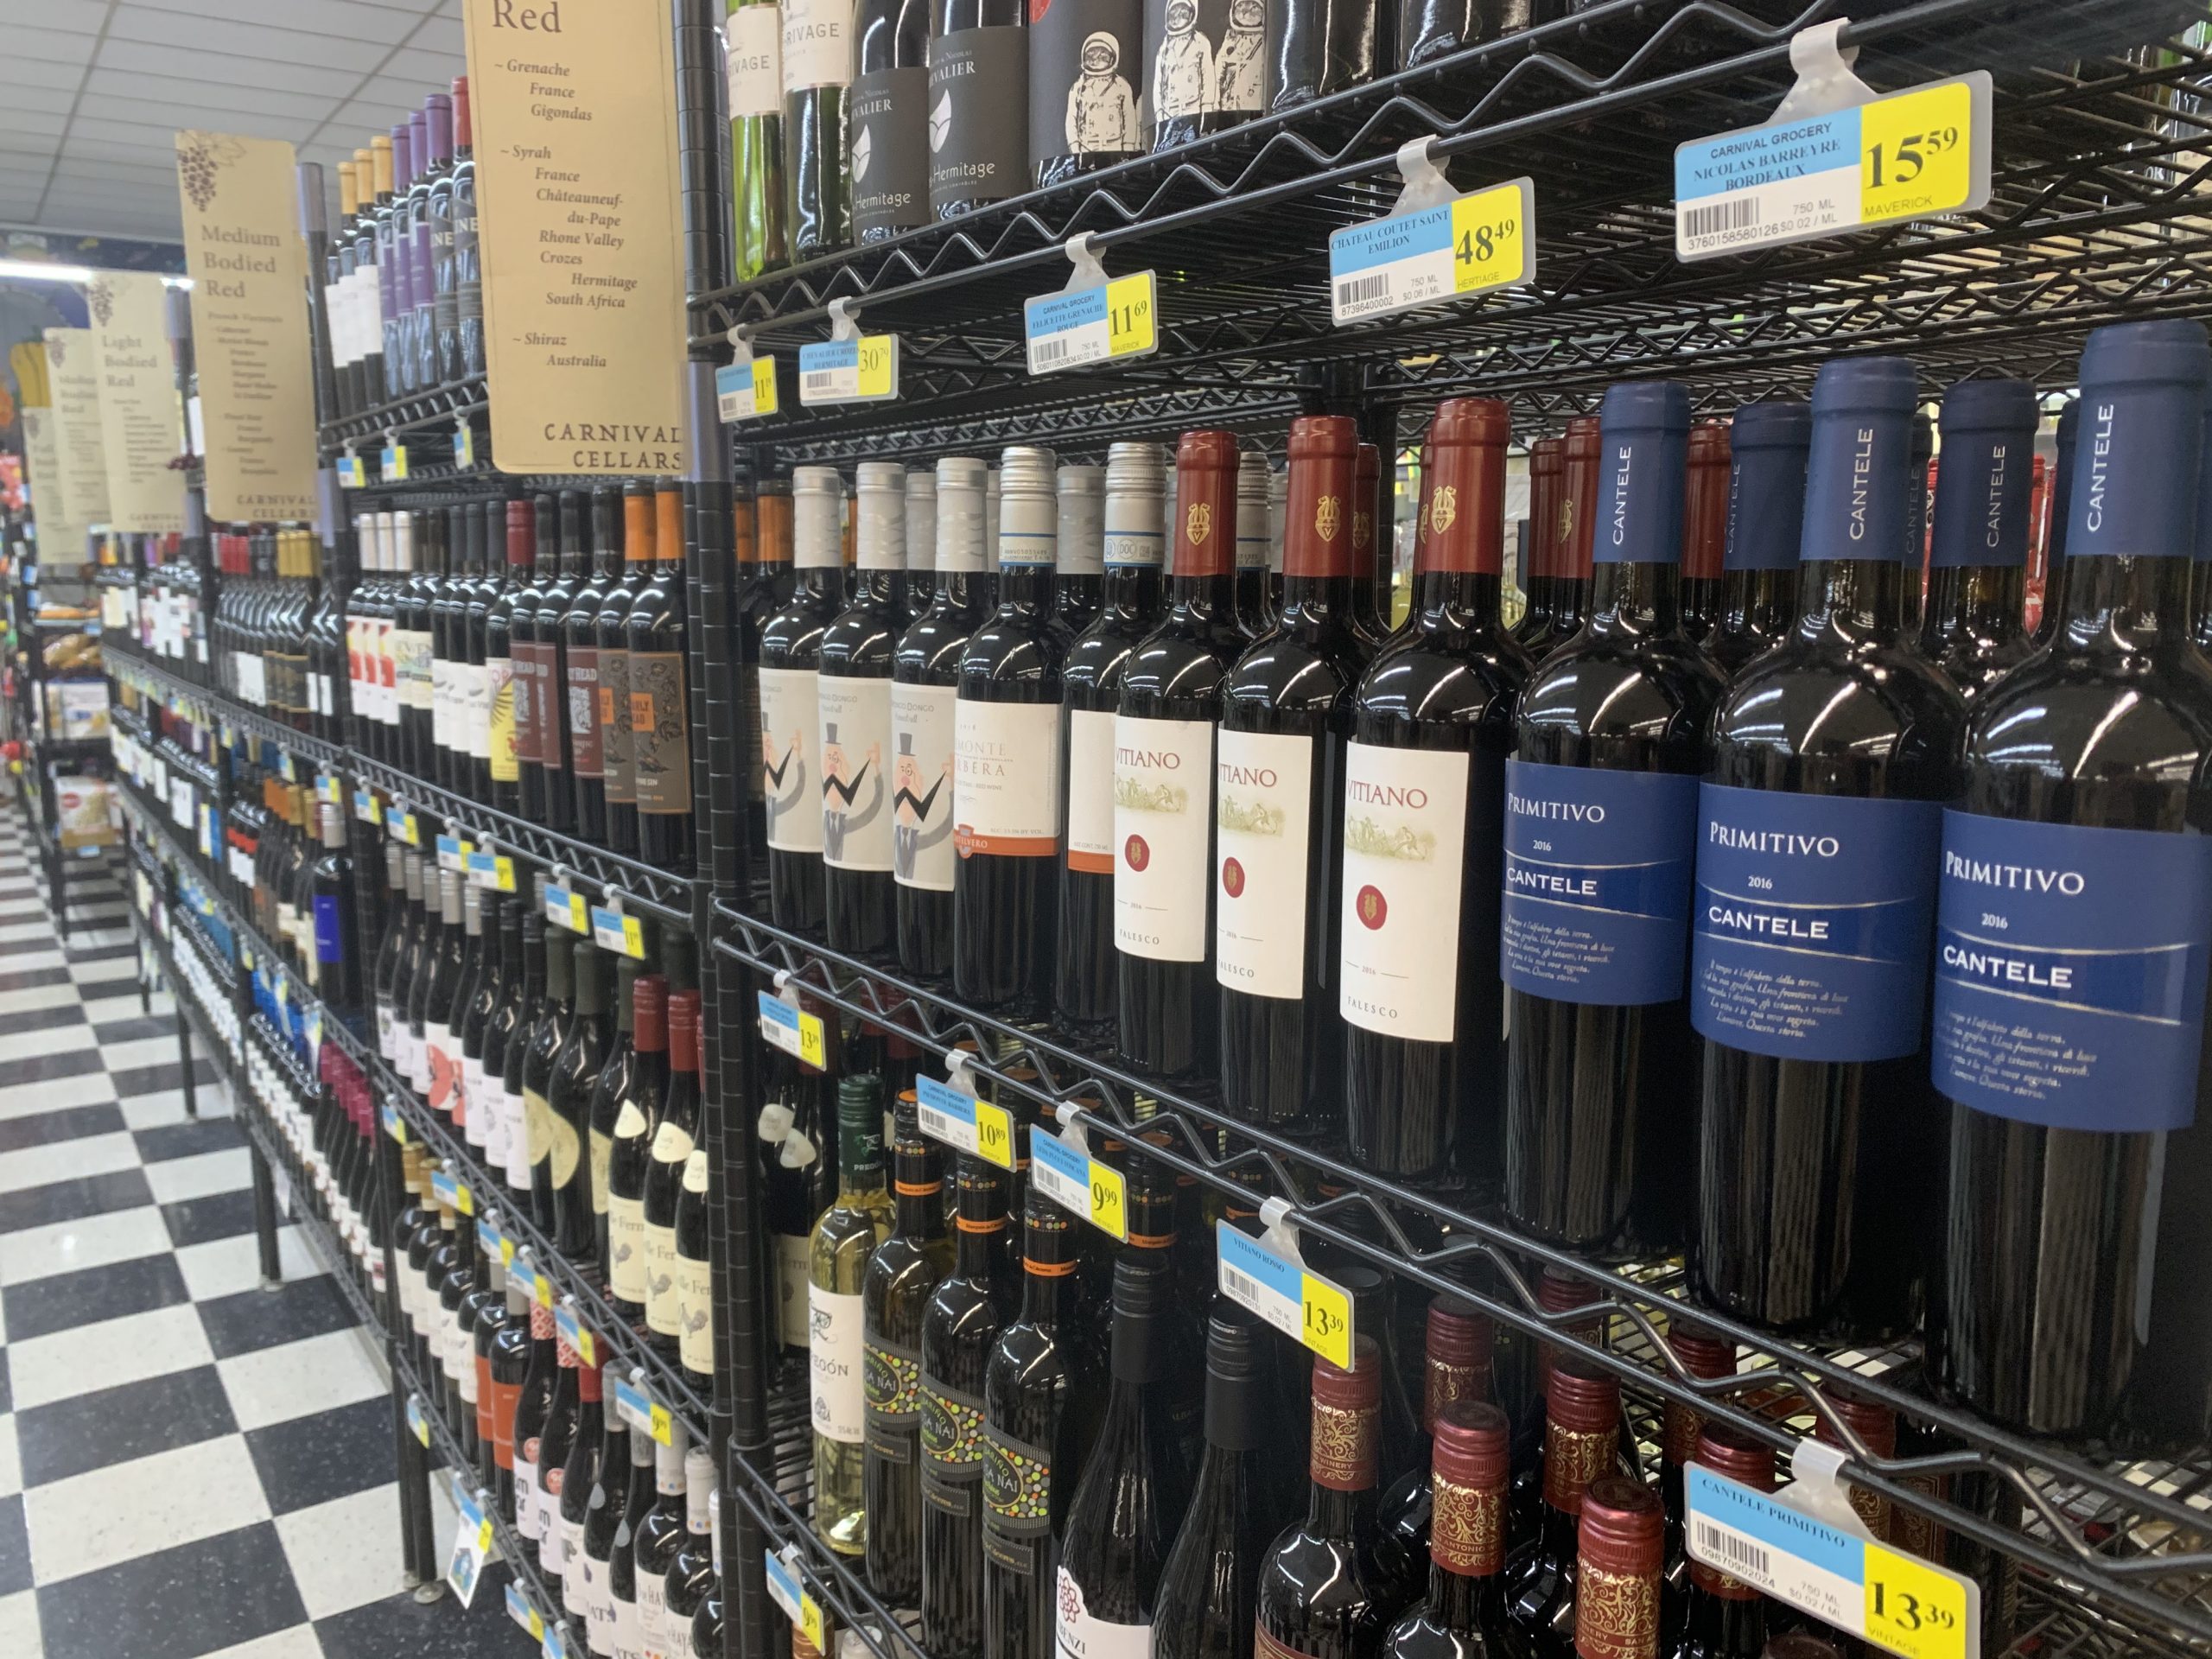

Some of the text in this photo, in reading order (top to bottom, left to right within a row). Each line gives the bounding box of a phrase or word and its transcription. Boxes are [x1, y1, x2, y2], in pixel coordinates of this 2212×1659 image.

[493, 0, 562, 33] Red
[507, 59, 570, 76] Grenache
[530, 82, 575, 98] France
[531, 104, 592, 121] Gigondas
[1710, 122, 1833, 159] CARNIVAL GROCERY
[512, 145, 551, 161] Syrah
[1694, 138, 1841, 181] NICOLAS BARREYRE
[535, 168, 580, 182] France
[1725, 163, 1807, 192] BORDEAUX
[1793, 199, 1836, 214] 750 ML
[1865, 195, 1934, 218] MAVERICK
[568, 211, 621, 229] du-Pape
[1821, 213, 1838, 224] ML
[202, 226, 280, 247] Medium
[1332, 210, 1450, 251] CHATEAU COUTET SAINT
[586, 232, 624, 250] Valley
[1368, 234, 1410, 254] EMILION
[203, 252, 276, 273] Bodied
[540, 251, 583, 264] Crozes
[207, 280, 245, 299] Red
[571, 273, 638, 291] Hermitage
[1410, 274, 1438, 287] 750 ML
[1458, 271, 1500, 289] HERTIAGE
[1428, 285, 1440, 295] ML
[546, 292, 626, 309] South Africa
[1043, 303, 1068, 315] CARNIVAL
[1057, 321, 1079, 333] ROUGE
[524, 333, 568, 346] Shiraz
[547, 354, 607, 367] Australia
[544, 423, 683, 443] CARNIVAL
[573, 451, 683, 470] CELLARS
[2087, 404, 2114, 533] CANTELE
[1849, 427, 1874, 542] CANTELE
[1612, 446, 1632, 546] CANTELE
[1986, 444, 2006, 549] CANTELE
[1728, 463, 1741, 554] CANTELE
[1116, 747, 1180, 770] VITIANO
[1347, 779, 1428, 810] VITIANO
[1508, 792, 1605, 823] PRIMITIVO
[1533, 839, 1552, 851] 2016
[1710, 821, 1840, 857] PRIMITIVO
[1507, 867, 1597, 896] CANTELE
[1946, 850, 2085, 895] PRIMITIVO
[1748, 875, 1773, 890] 2016
[1708, 906, 1829, 939] CANTELE
[1981, 912, 2008, 930] 2016
[1120, 929, 1160, 945] FALESCO
[1362, 964, 1376, 976] 2016
[1943, 945, 2073, 988] CANTELE
[1347, 995, 1398, 1019] FALESCO
[1233, 1236, 1285, 1273] VITIANO ROSSO
[1320, 1458, 1353, 1470] WINERY
[1702, 1478, 1846, 1548] CANTELE PRIMITIVO
[1444, 1536, 1485, 1553] ANTONIO
[1801, 1580, 1840, 1606] 750 ML
[1827, 1607, 1843, 1620] ML
[1867, 1626, 1921, 1657] VINTAGE
